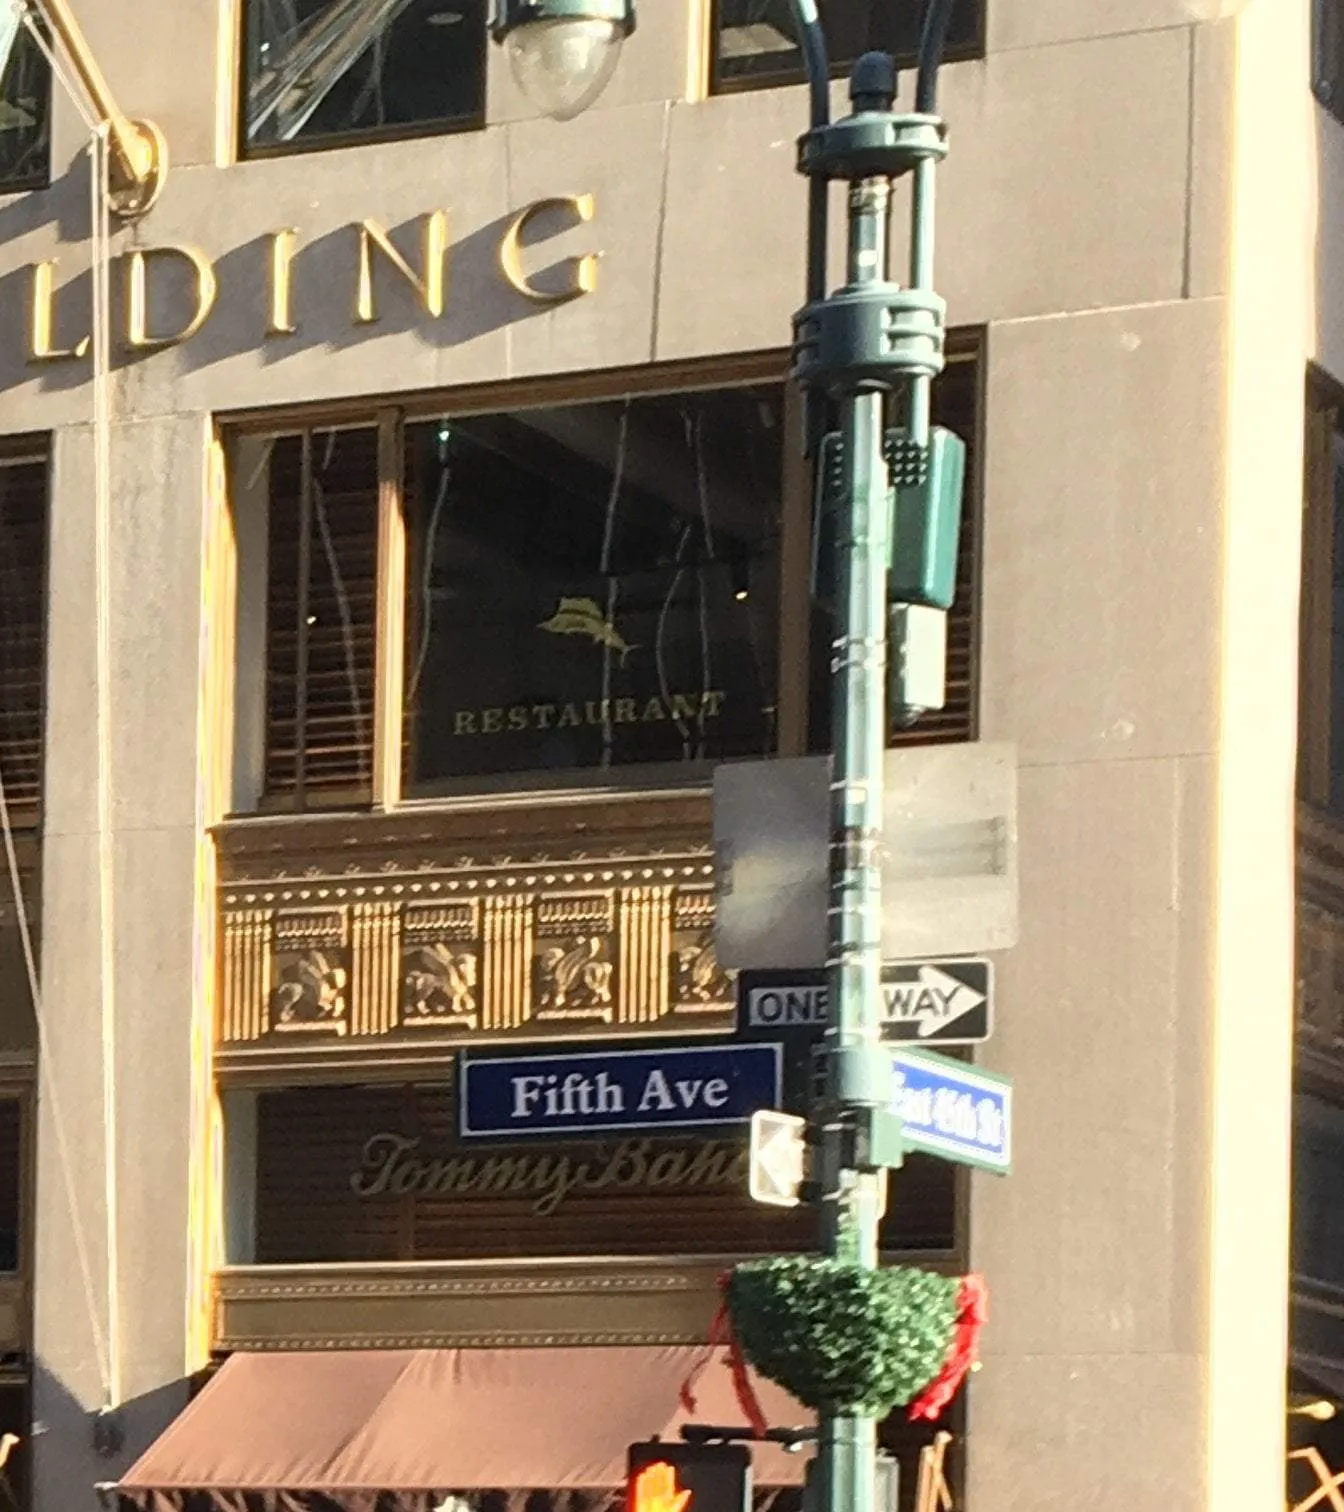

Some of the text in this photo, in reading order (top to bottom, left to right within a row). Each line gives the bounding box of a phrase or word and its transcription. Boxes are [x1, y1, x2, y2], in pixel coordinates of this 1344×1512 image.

[452, 690, 727, 738] RESTAURANT
[756, 984, 961, 1023] ONE WAY
[510, 1065, 730, 1118] Fifth Ave
[348, 1131, 576, 1216] Tommy
